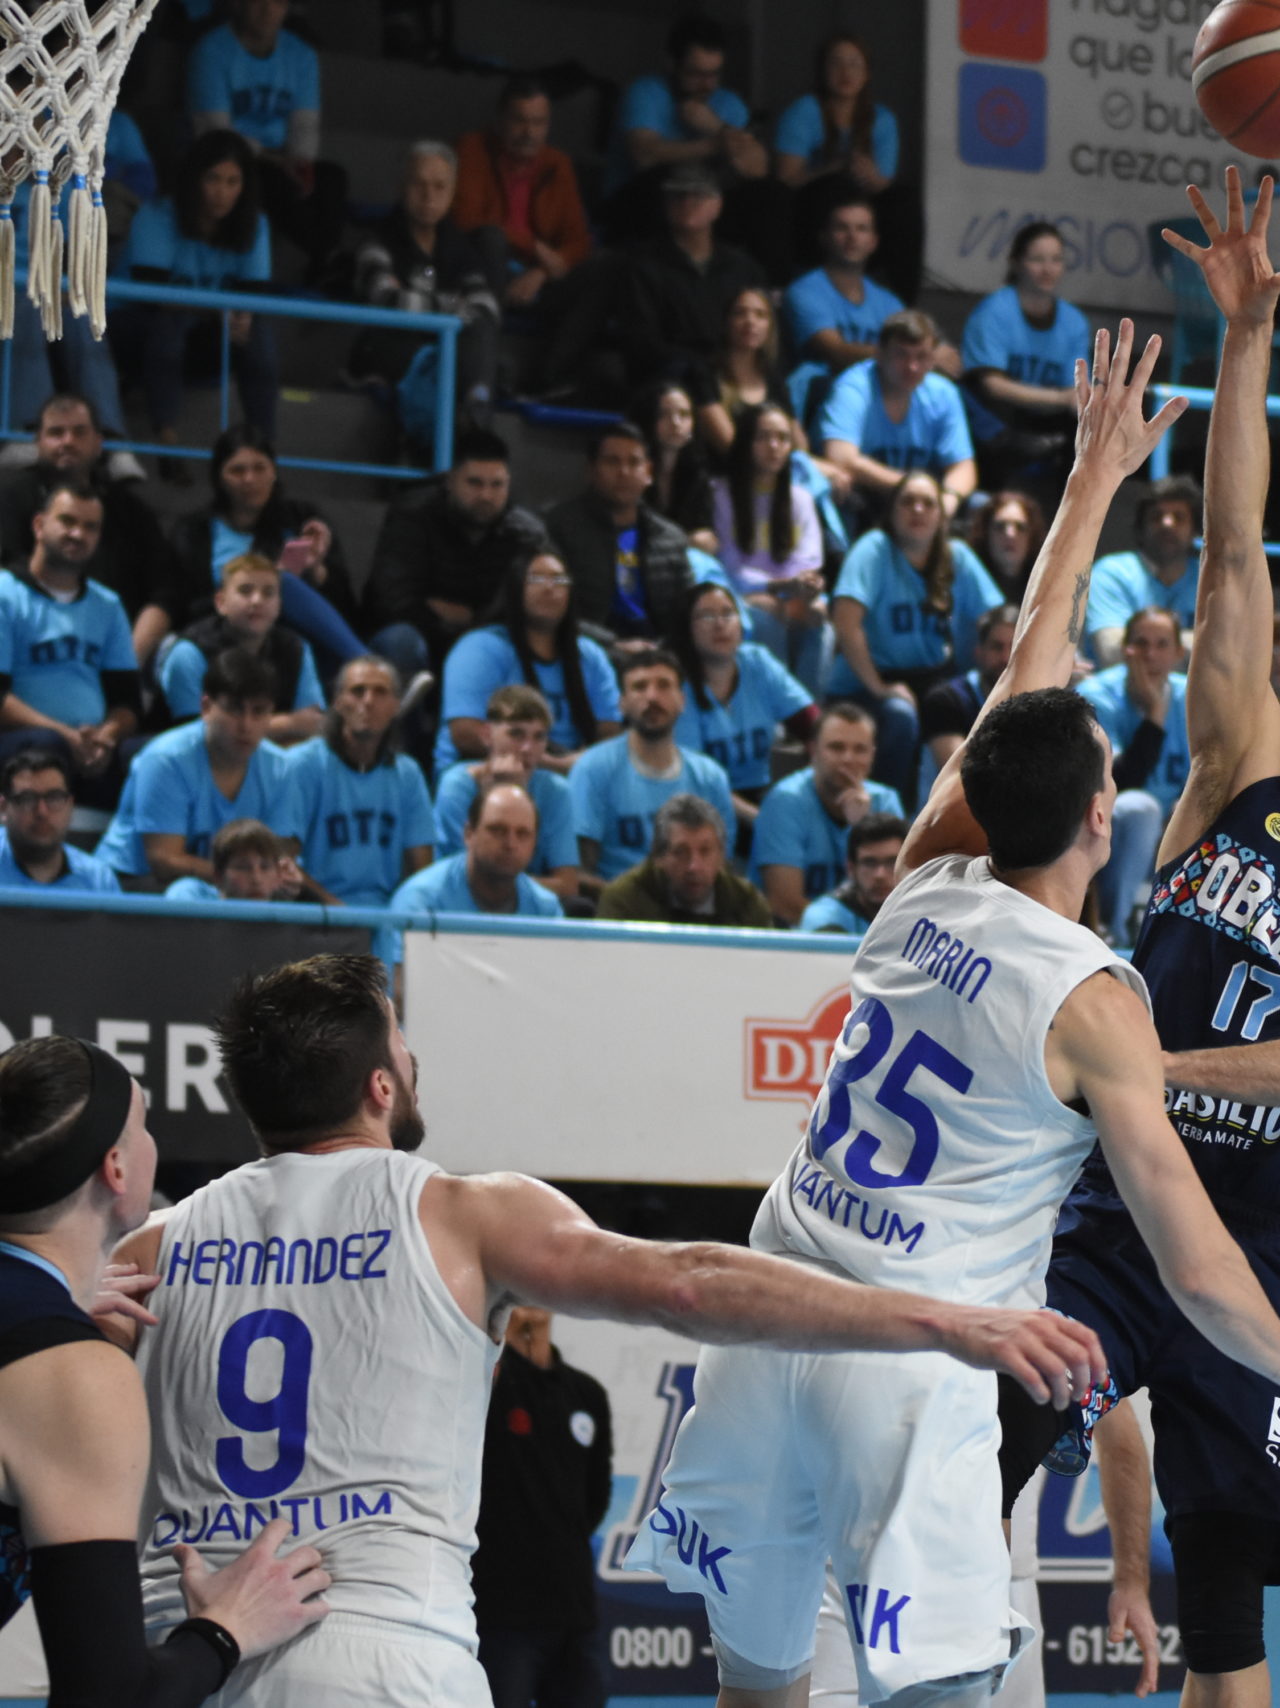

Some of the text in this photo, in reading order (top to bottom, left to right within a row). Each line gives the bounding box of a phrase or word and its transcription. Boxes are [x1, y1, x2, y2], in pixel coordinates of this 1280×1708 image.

[1069, 35, 1154, 78] que
[1069, 142, 1211, 190] crezca
[901, 917, 992, 1004] MARIN
[166, 1228, 393, 1287] HERNANDEZ
[214, 1308, 314, 1500] 9
[152, 1491, 392, 1548] QUANTUM
[610, 1626, 693, 1669] 0800
